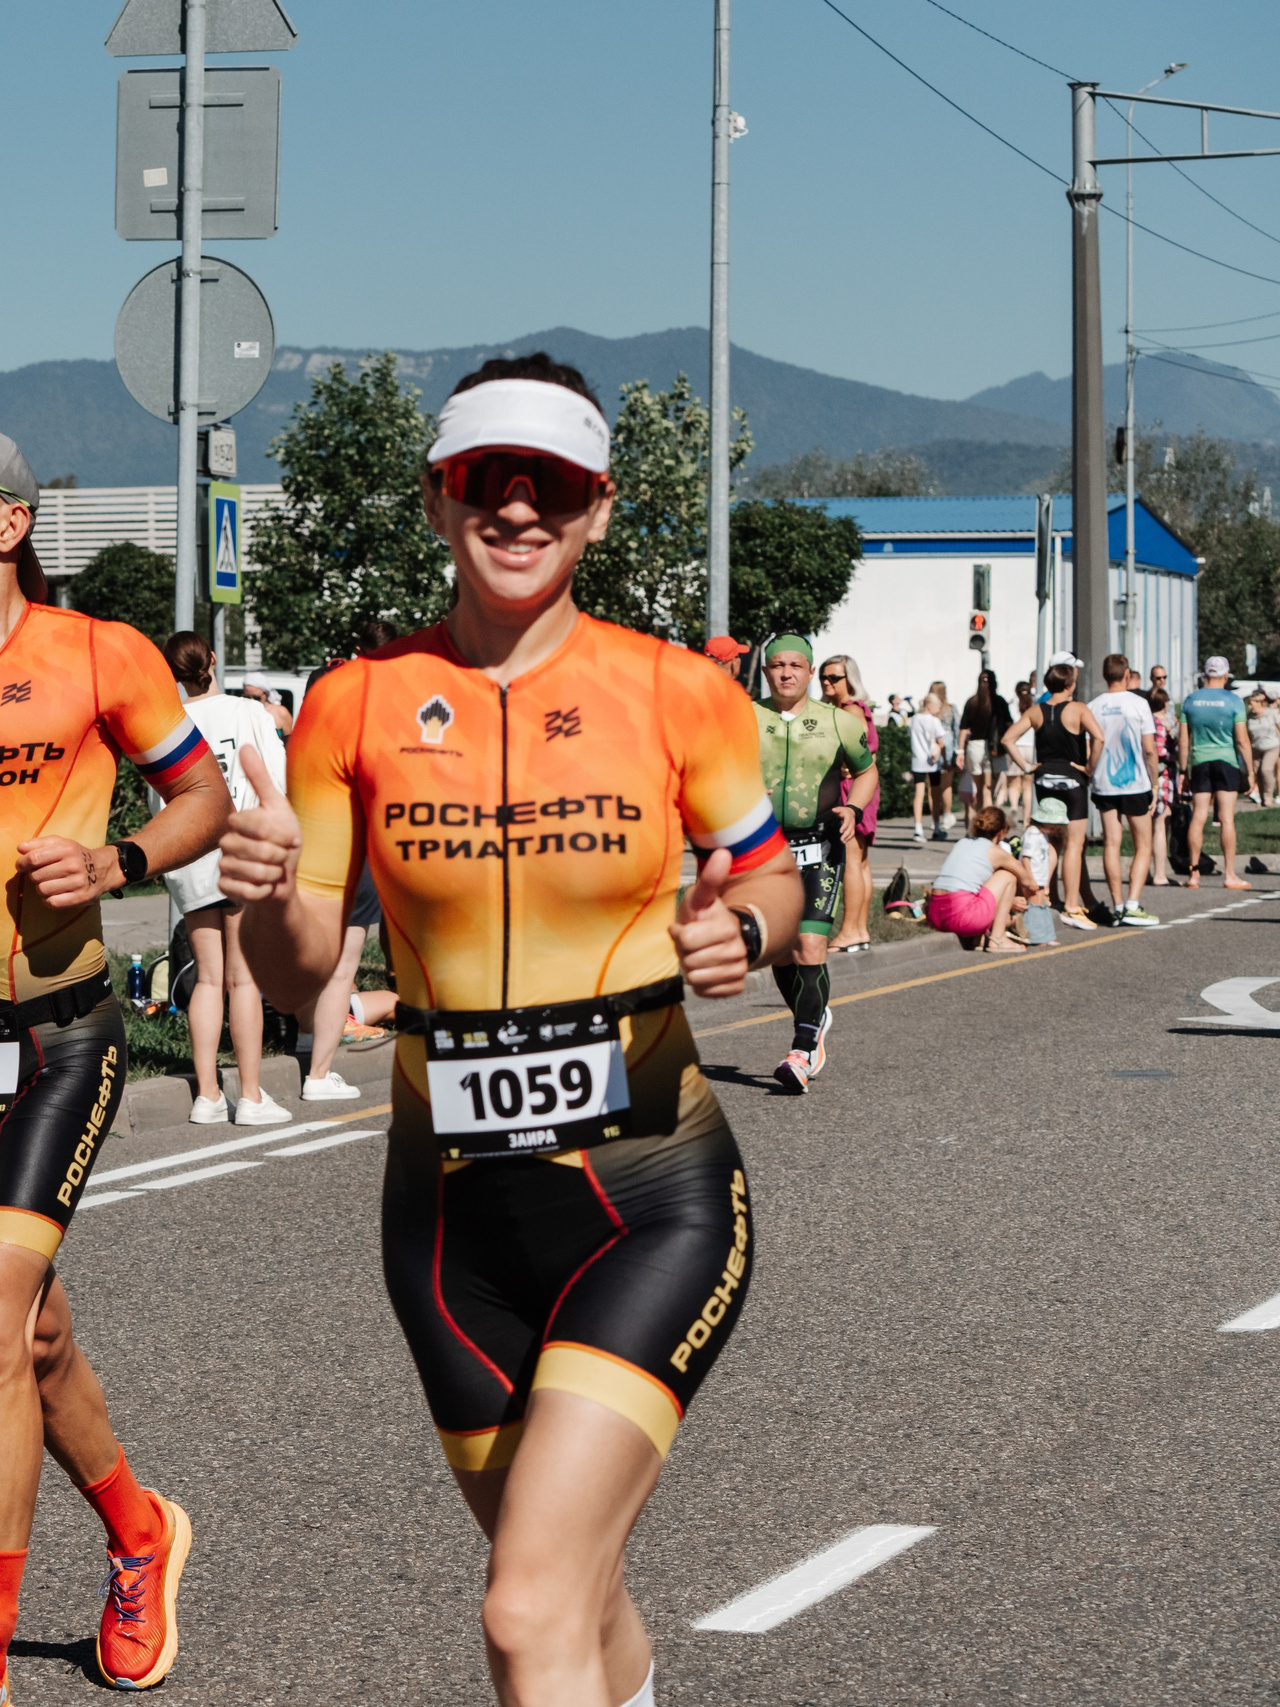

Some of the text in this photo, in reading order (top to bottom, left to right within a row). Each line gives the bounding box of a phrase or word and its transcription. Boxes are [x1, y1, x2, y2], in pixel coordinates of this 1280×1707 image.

[385, 795, 642, 828] РОСНЕФТЬ
[396, 832, 627, 860] ТРИАТЛОН
[459, 1059, 593, 1121] 1059
[56, 1045, 119, 1208] РОСНЕФТЬ
[670, 1169, 748, 1374] РОСНЕФТЬ
